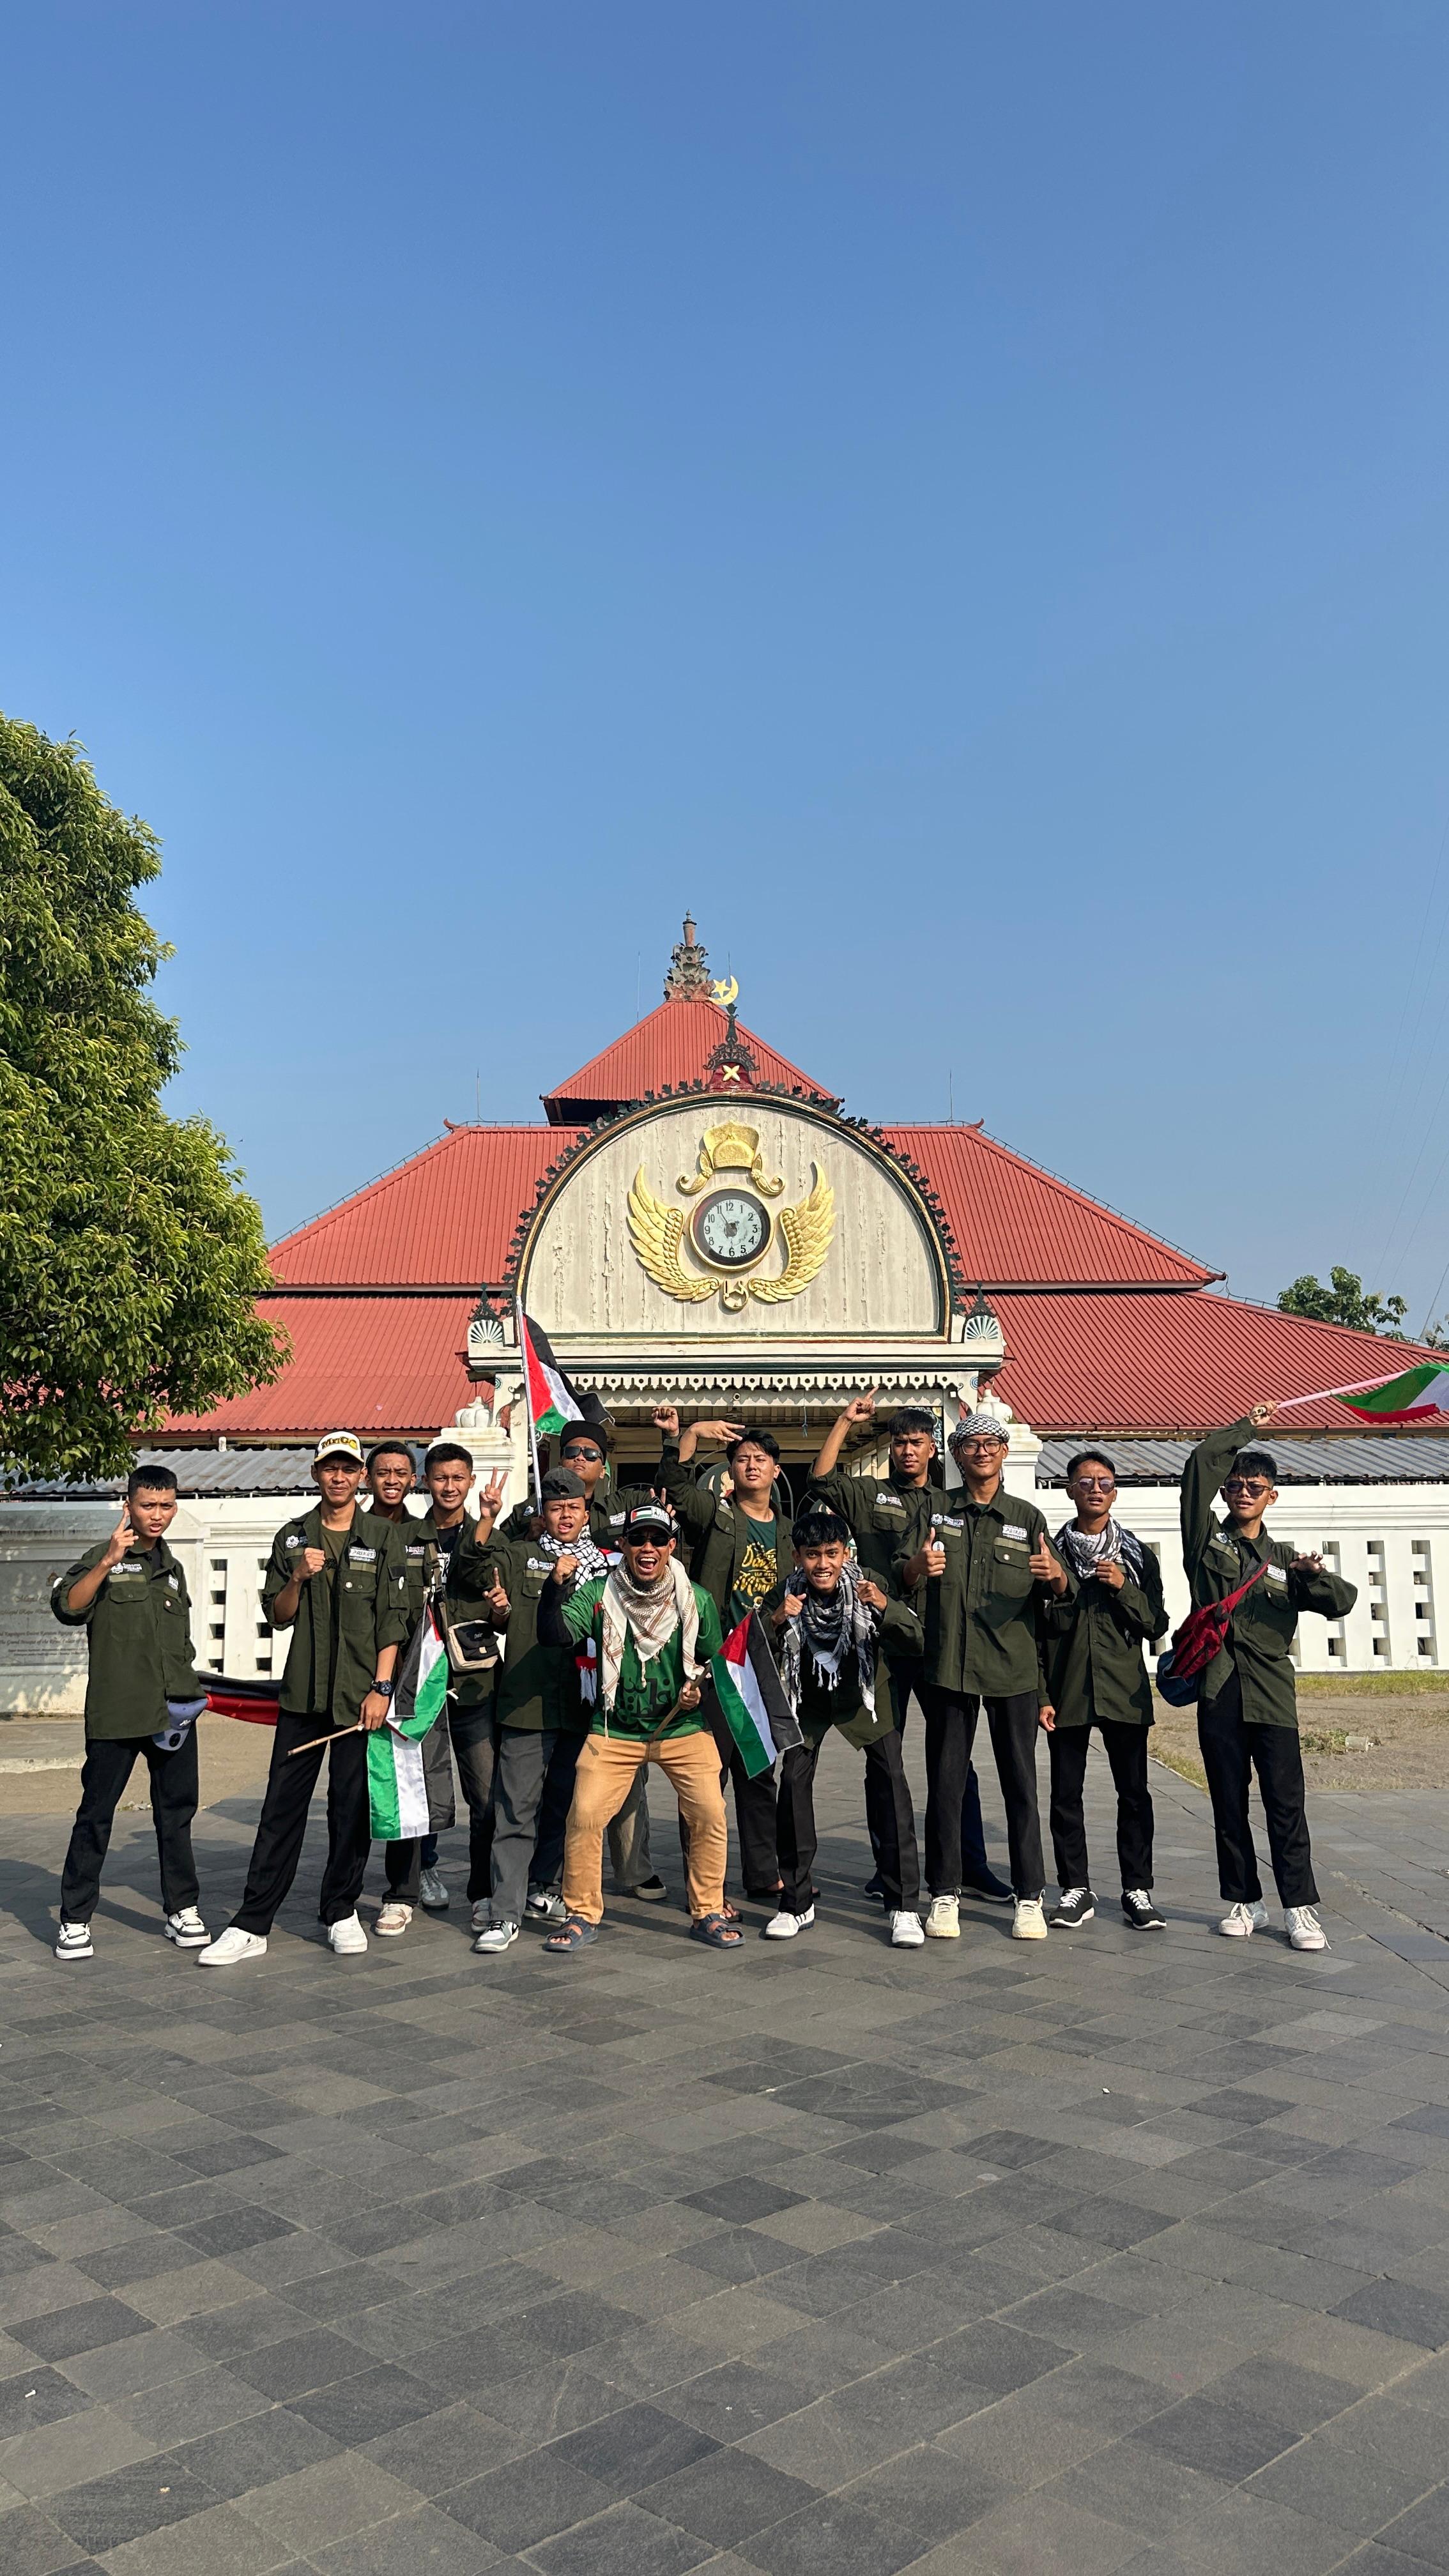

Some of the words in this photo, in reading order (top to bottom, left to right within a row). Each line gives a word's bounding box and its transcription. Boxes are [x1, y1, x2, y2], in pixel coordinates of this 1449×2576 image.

[717, 1206, 722, 1214] 11
[726, 1202, 733, 1211] 12
[740, 1205, 743, 1213] 1
[708, 1215, 715, 1223] 10
[747, 1213, 753, 1221] 2
[705, 1226, 710, 1234] 9
[752, 1224, 758, 1233] 3
[709, 1237, 714, 1245] 8
[748, 1236, 754, 1245] 4
[718, 1246, 723, 1254] 7
[729, 1247, 735, 1256] 6
[740, 1245, 746, 1254] 5
